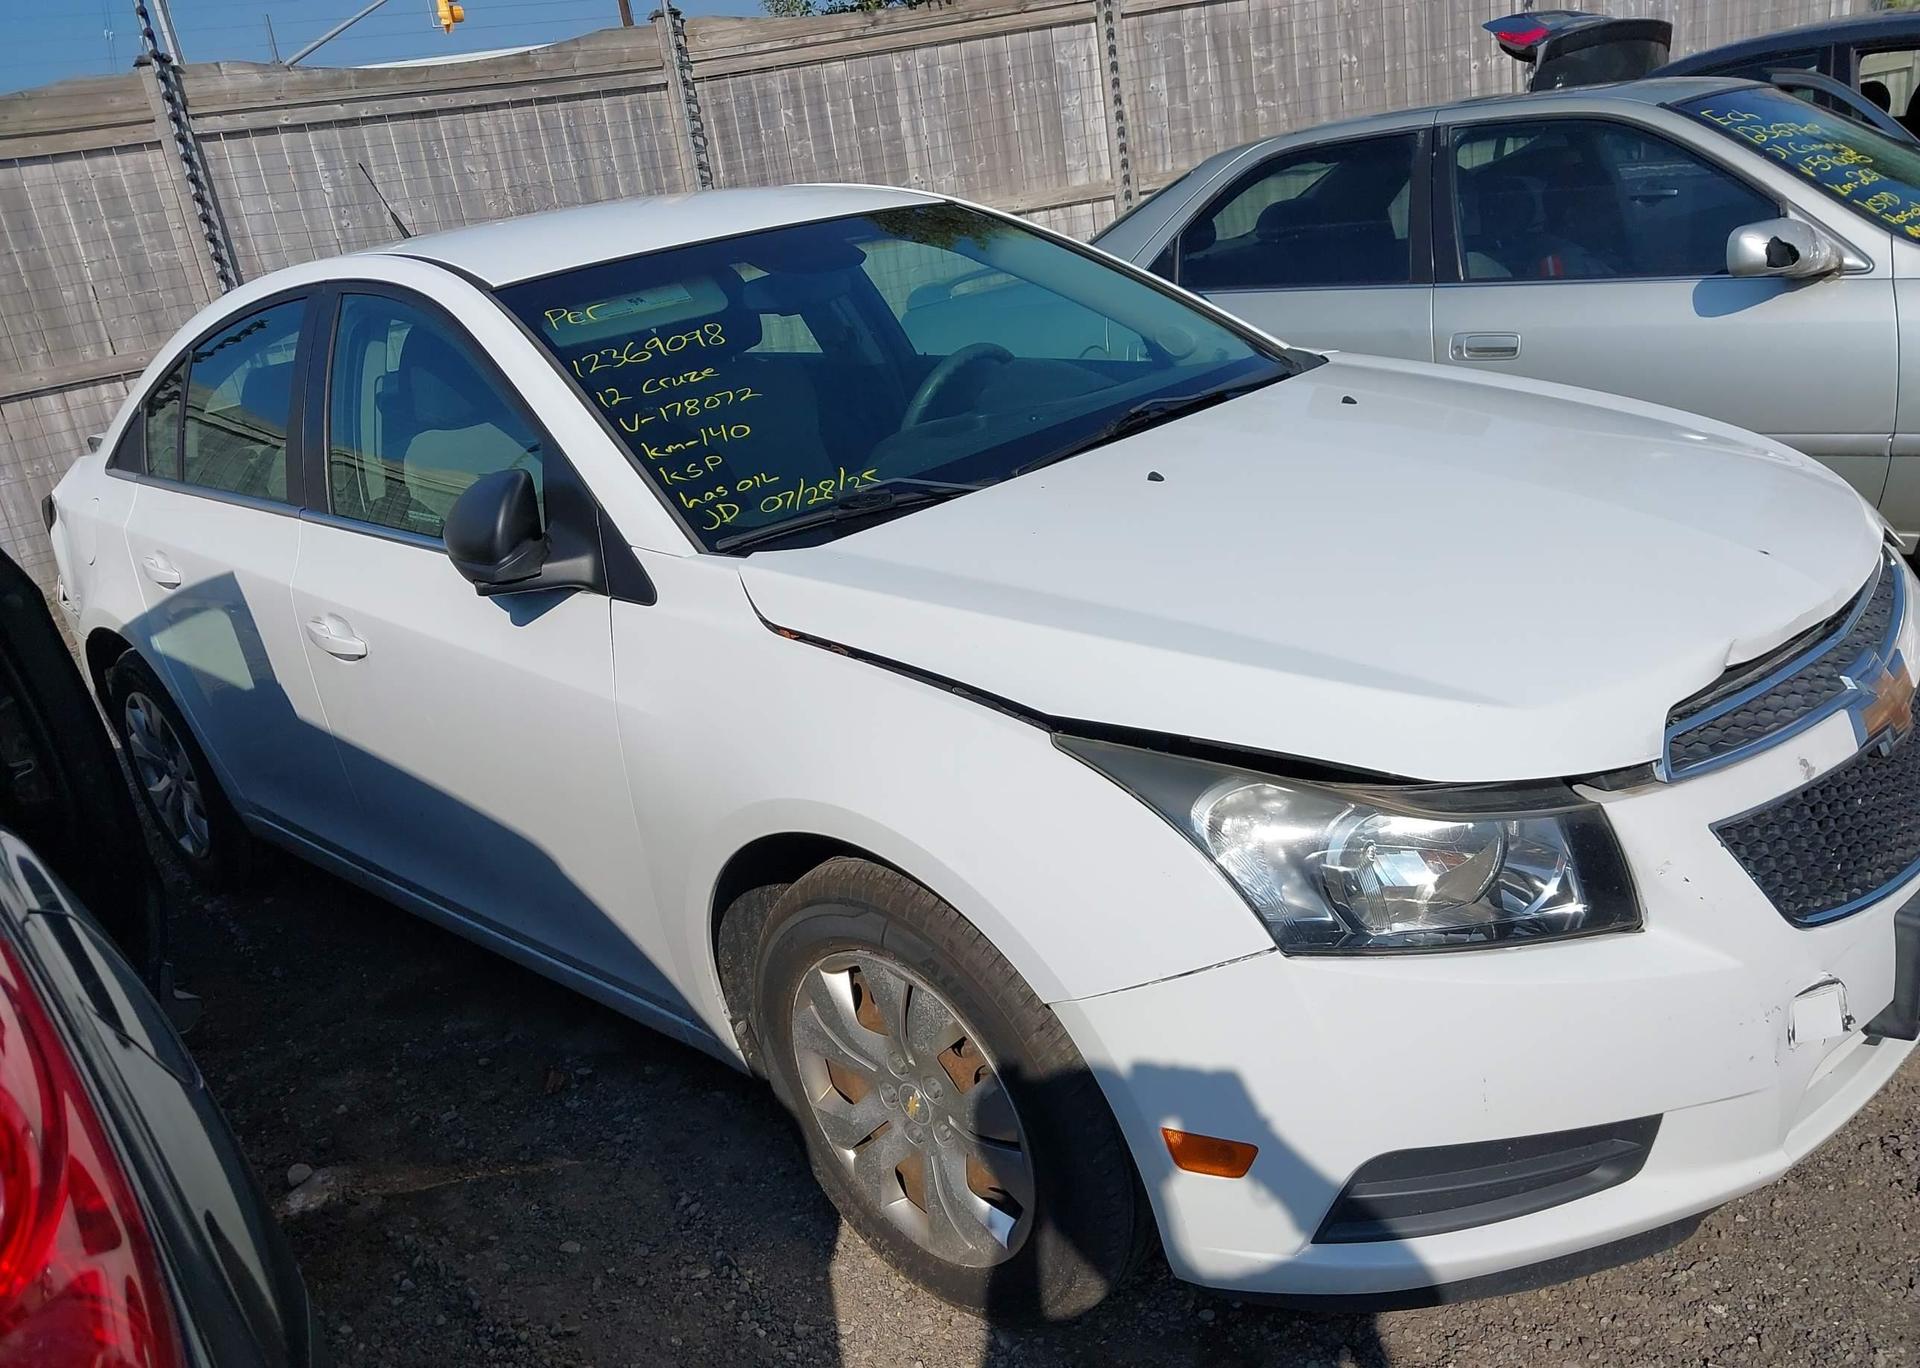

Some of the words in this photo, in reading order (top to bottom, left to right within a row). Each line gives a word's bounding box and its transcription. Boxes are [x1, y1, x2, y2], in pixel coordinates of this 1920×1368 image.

[572, 323, 726, 379] 12369098
[596, 388, 633, 408] 12
[702, 503, 740, 531] JD
